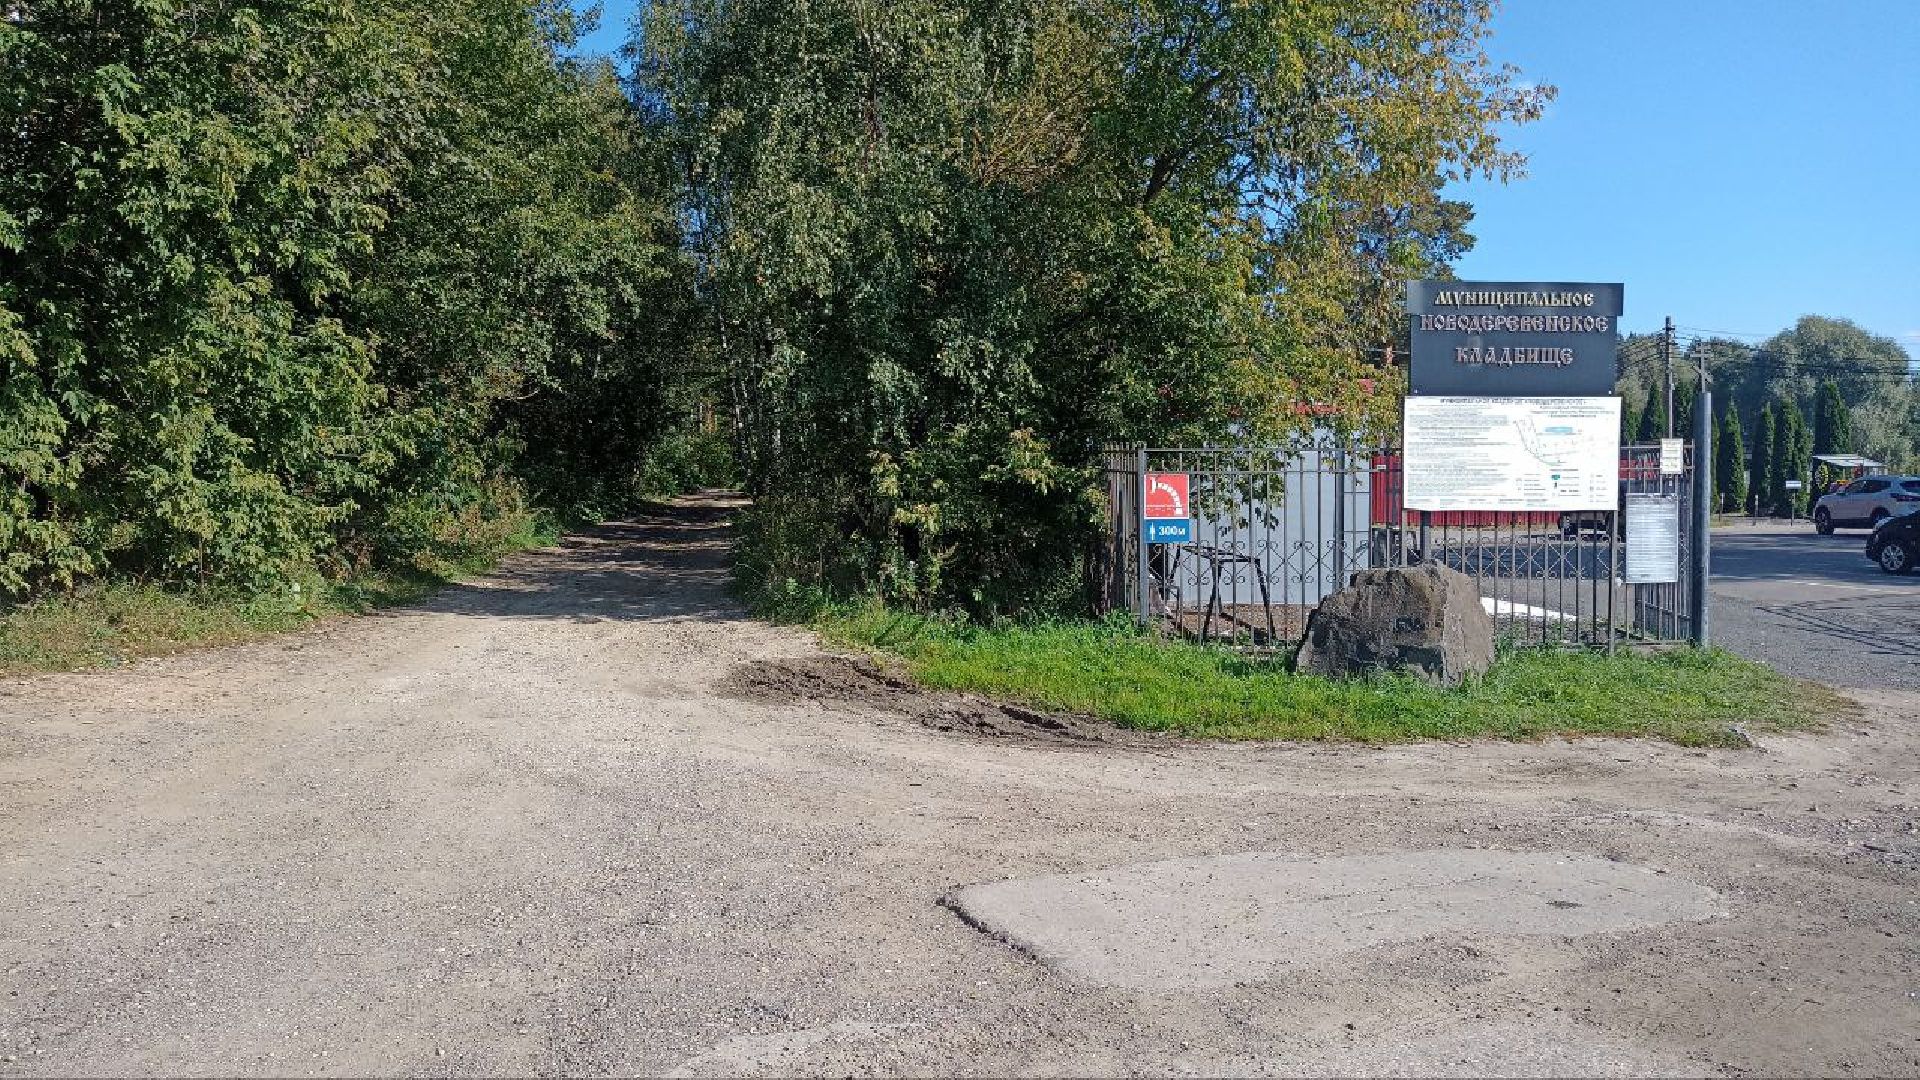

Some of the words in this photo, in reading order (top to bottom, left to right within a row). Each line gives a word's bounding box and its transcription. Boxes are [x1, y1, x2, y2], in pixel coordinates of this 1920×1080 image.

[1435, 291, 1594, 309] МУНИЦИПАЛЬНОЕ
[1421, 315, 1608, 333] НОВОДЕРЕВЕНСКОЕ
[1456, 347, 1573, 367] КЛАДБИЩЕ
